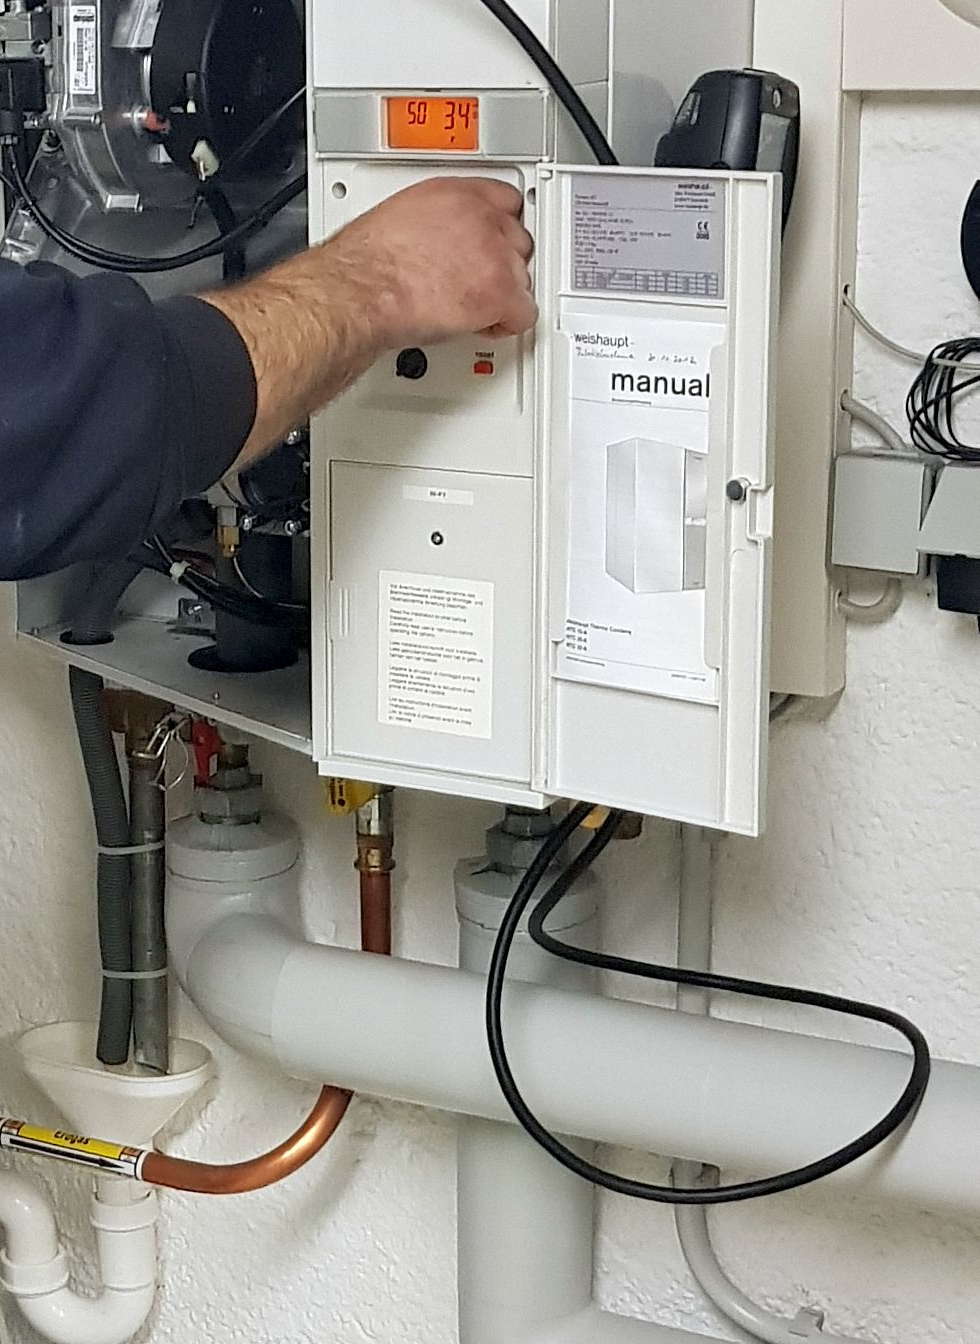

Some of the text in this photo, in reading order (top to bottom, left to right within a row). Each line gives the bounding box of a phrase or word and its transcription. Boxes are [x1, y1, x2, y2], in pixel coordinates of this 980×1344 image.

[407, 101, 470, 130] 50 34
[611, 372, 710, 398] manual
